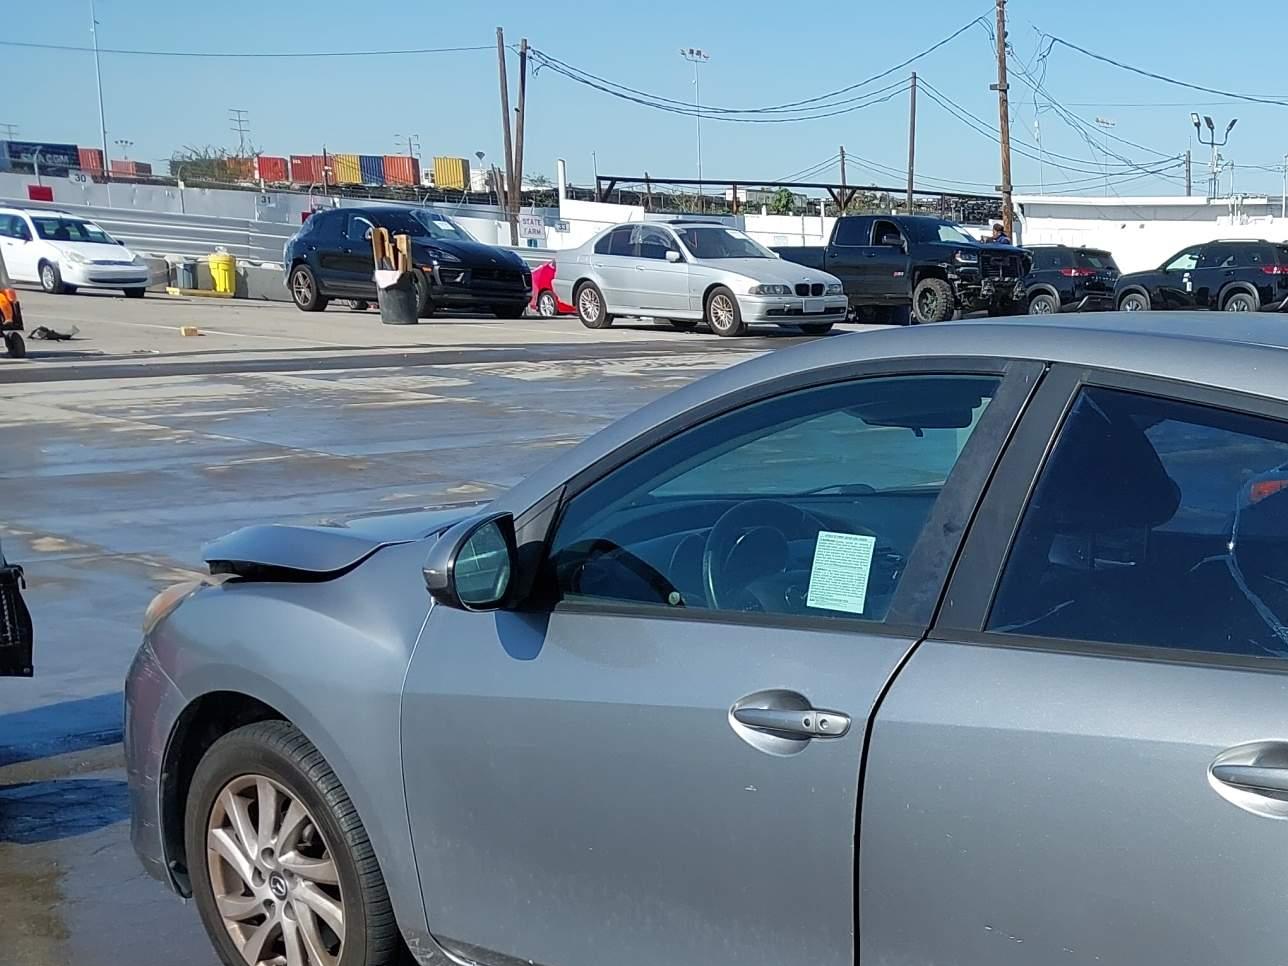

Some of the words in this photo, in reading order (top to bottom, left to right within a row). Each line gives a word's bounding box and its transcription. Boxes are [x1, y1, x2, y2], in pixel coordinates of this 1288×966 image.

[75, 174, 87, 183] 30
[261, 195, 271, 204] 31
[522, 218, 542, 226] STATE
